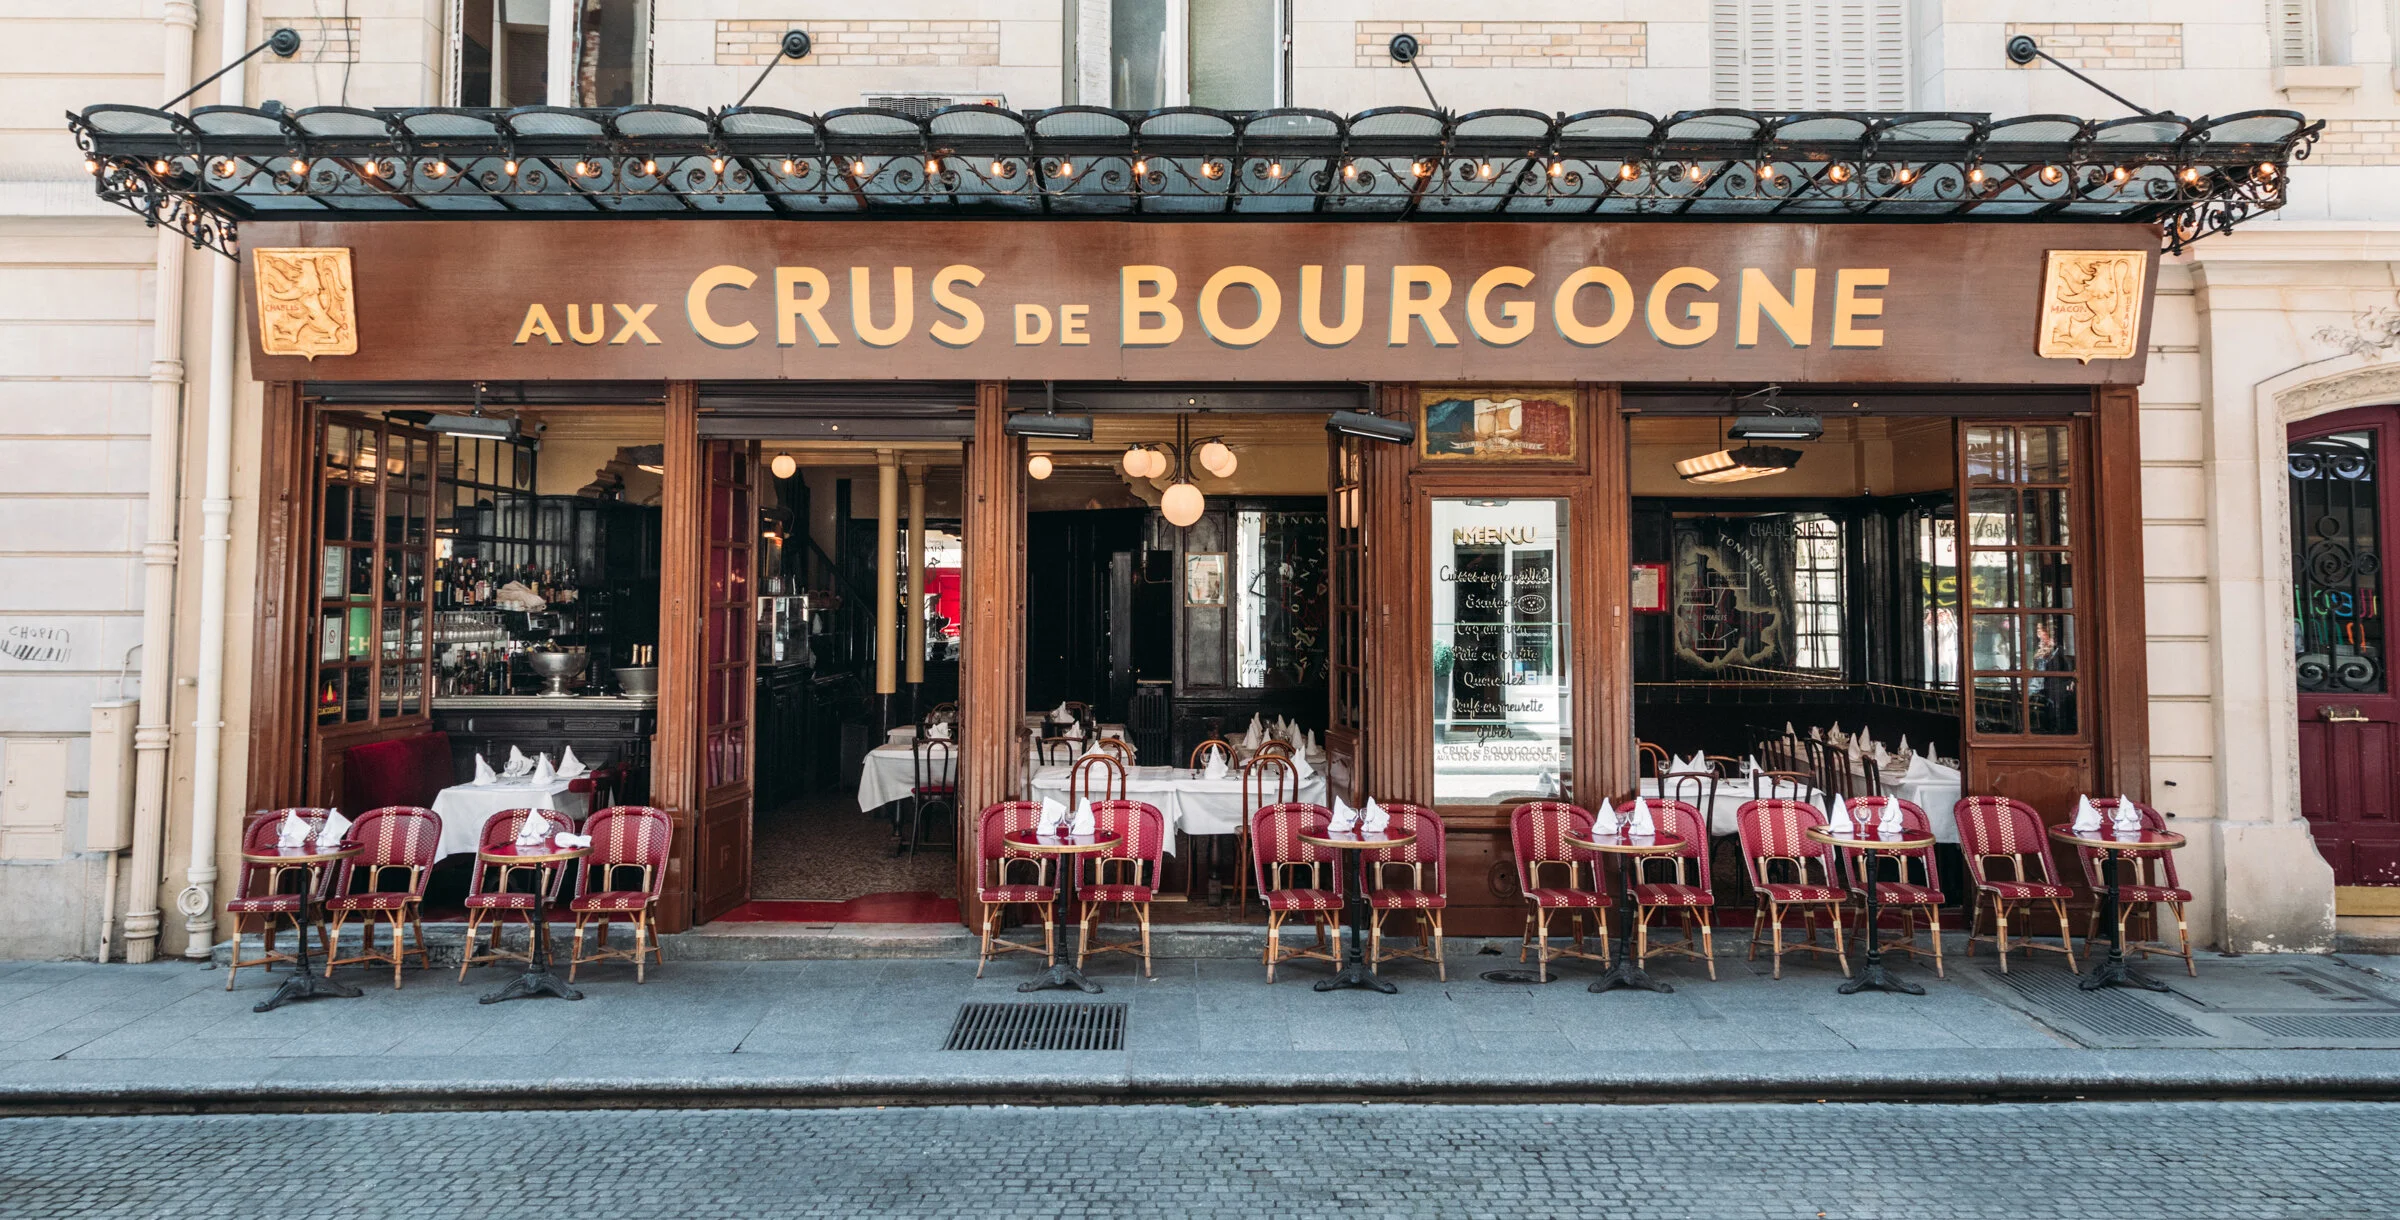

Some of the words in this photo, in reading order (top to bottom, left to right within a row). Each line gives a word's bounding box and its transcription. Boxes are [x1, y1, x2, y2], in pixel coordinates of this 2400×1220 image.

[264, 303, 299, 312] CHABLIS
[514, 303, 663, 345] AUX
[686, 264, 987, 348] CRUS
[1014, 303, 1092, 345] DE
[1120, 264, 1891, 349] BOURGOGNE
[338, 304, 350, 340] LYON
[2120, 296, 2133, 348] BEAUNE
[1453, 526, 1537, 545] MENU
[1749, 521, 1825, 538] CHABLISIEN
[1719, 532, 1779, 598] TONNERROIS
[1463, 671, 1526, 688] Quenelles
[1498, 698, 1545, 713] meurette
